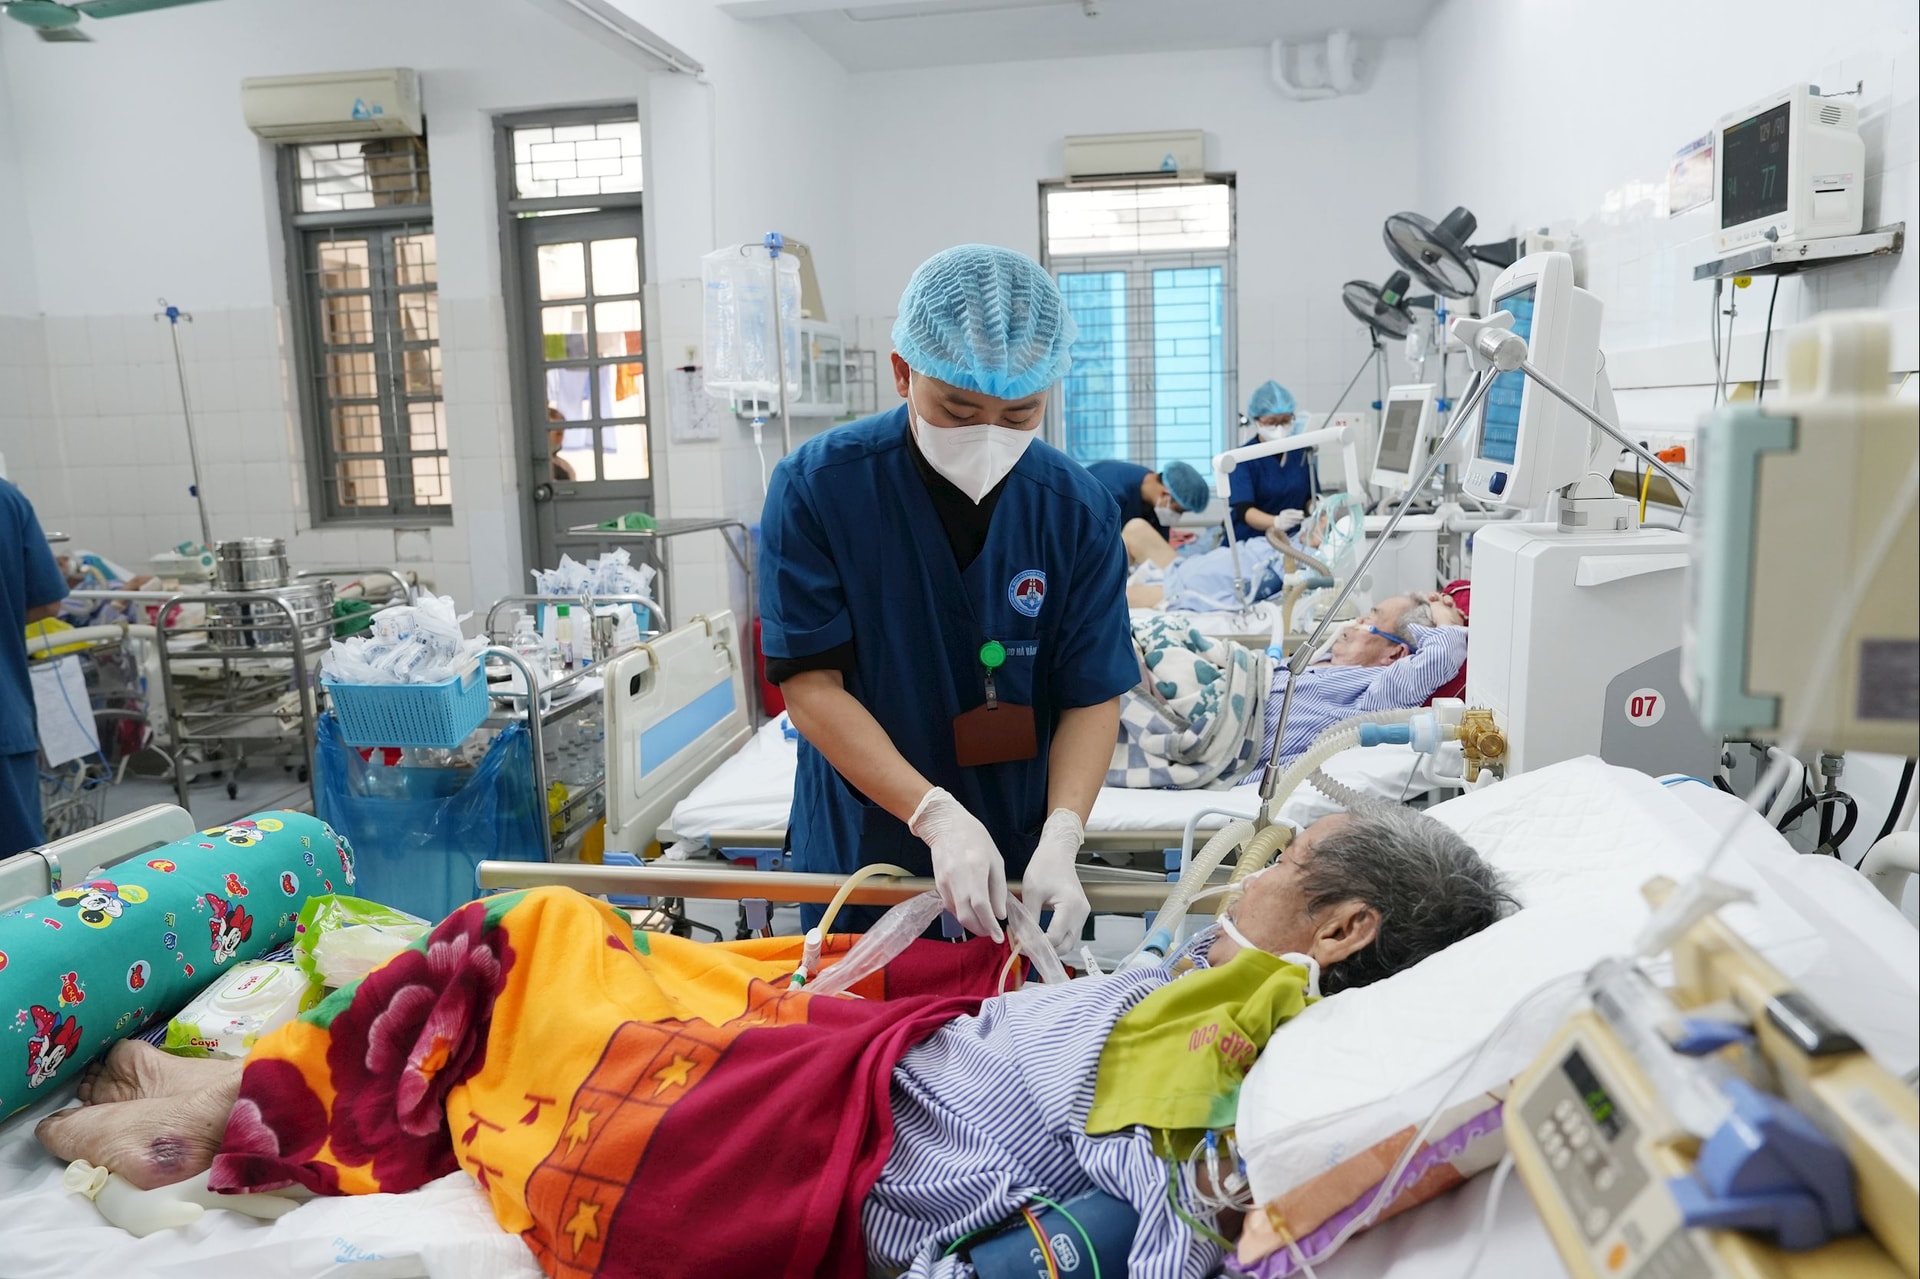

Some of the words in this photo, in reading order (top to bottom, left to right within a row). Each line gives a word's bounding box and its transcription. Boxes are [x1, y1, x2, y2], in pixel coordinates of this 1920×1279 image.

[1762, 165, 1777, 200] 77
[1630, 695, 1658, 718] 07
[190, 1037, 218, 1048] Caysi
